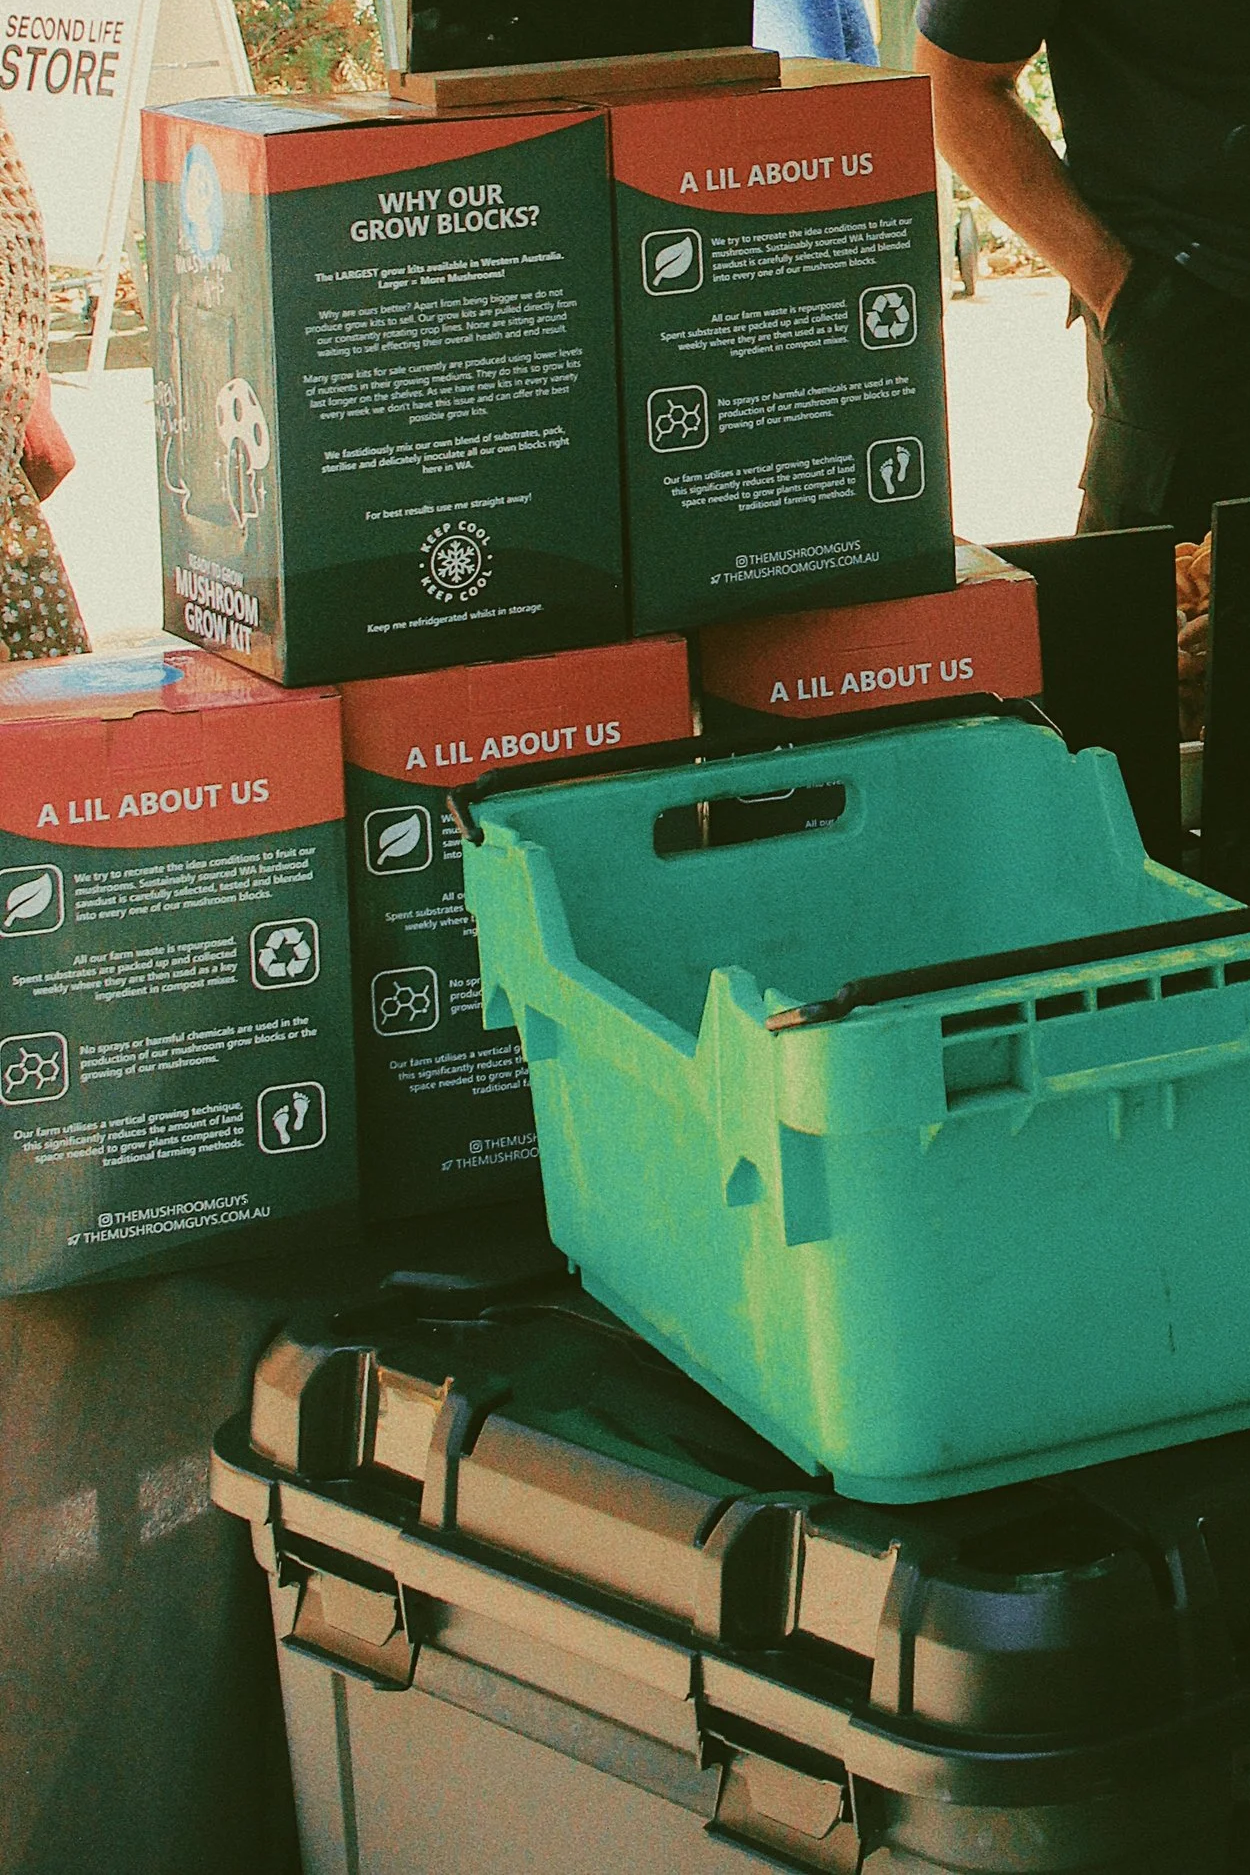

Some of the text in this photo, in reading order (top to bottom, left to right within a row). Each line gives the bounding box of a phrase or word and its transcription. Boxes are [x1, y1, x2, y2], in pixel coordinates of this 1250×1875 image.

[6, 14, 124, 44] SECOND LIFE
[0, 43, 121, 98] STORE
[680, 153, 873, 193] A LIL ABOUT US
[378, 184, 503, 215] WHY OUR
[352, 205, 540, 241] GROW BLOCKS?
[366, 511, 381, 520] For
[383, 508, 402, 518] best
[404, 504, 434, 516] results
[436, 503, 452, 512] use
[454, 501, 468, 510] me
[470, 496, 505, 508] straight
[420, 520, 490, 554] KEEP COOL
[748, 539, 861, 565] THEMUSHROOMGUYS
[723, 551, 880, 583] THEMUSHROOMGUYS.COM.AU
[175, 566, 259, 627] MUSHROOM
[420, 569, 492, 604] KEEP COOL
[184, 602, 252, 655] GROW KIT
[368, 623, 390, 633] Keep
[392, 621, 407, 630] me
[408, 611, 467, 628] refridgerated
[468, 608, 496, 619] whilst
[498, 607, 507, 616] in
[770, 657, 973, 703] A LIL ABOUT US
[406, 721, 620, 770] A LIL ABOUT US
[38, 779, 268, 827] A LIL ABOUT US
[83, 1205, 270, 1243] THEMUSHROOMGUYS.COM.AU
[114, 1193, 248, 1223] THEMUSHROOMGUYS
